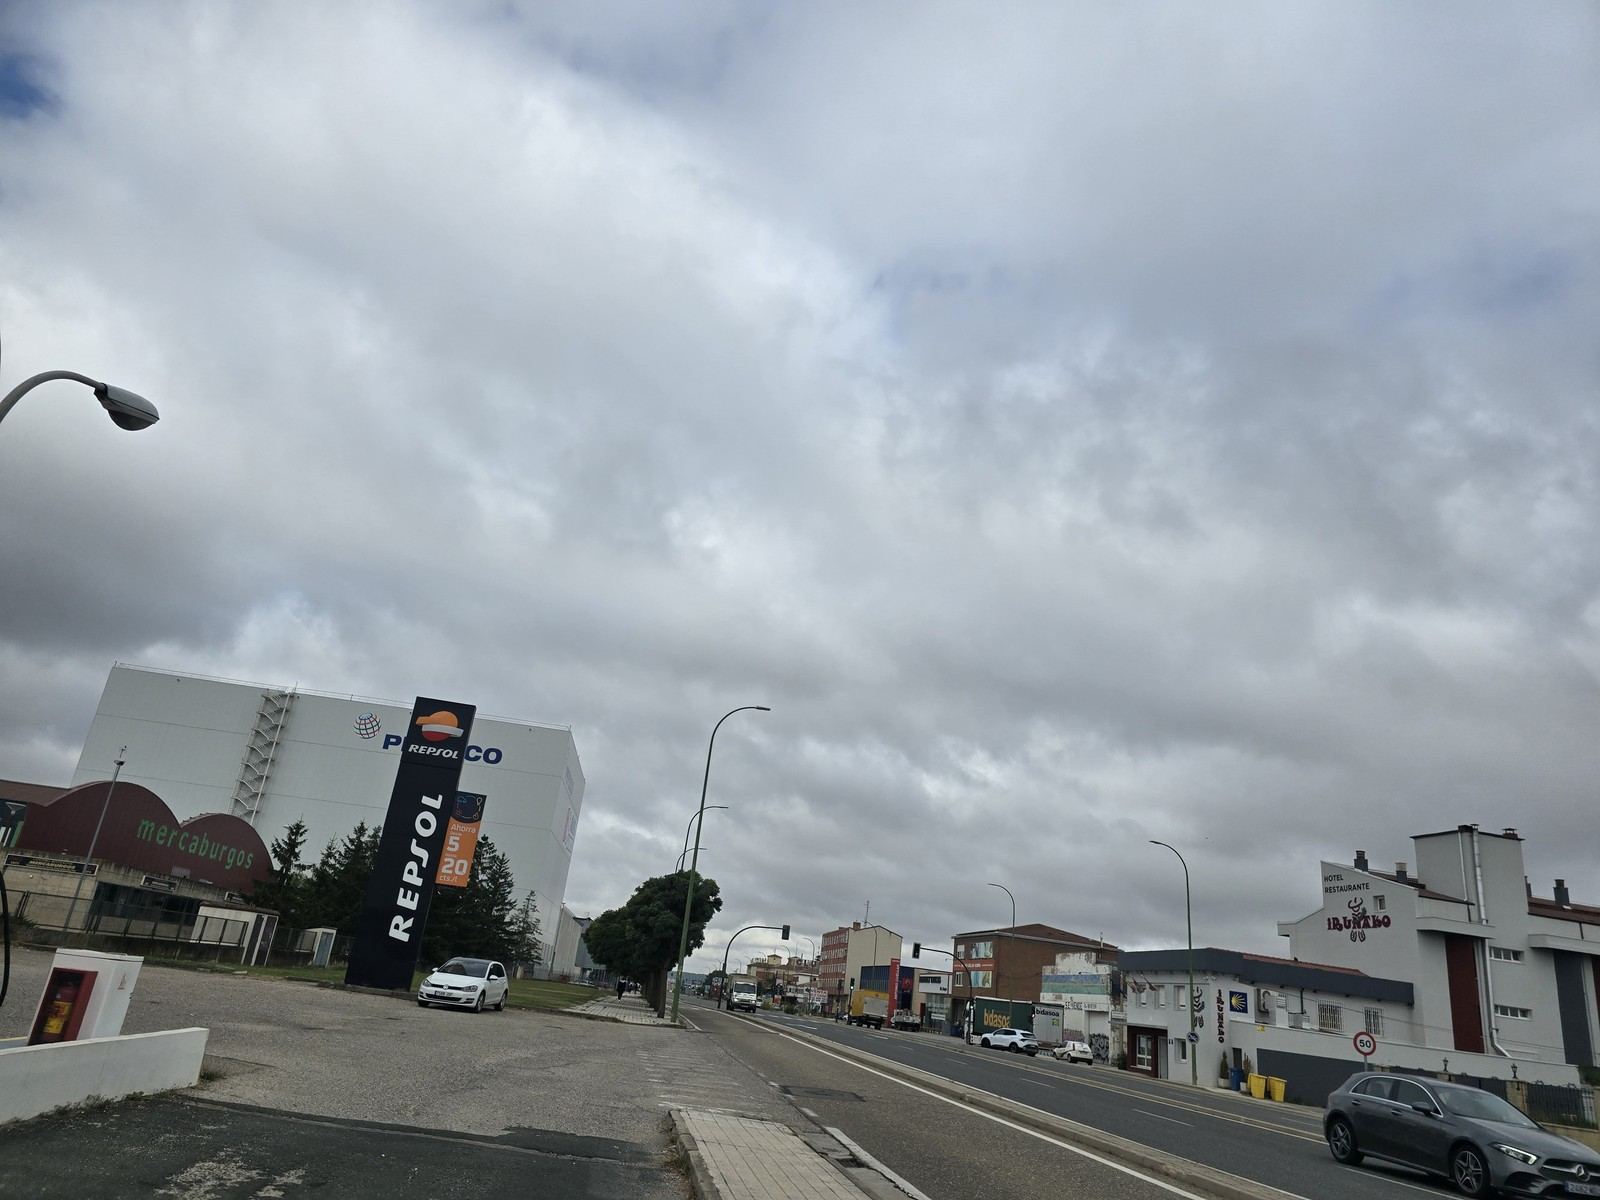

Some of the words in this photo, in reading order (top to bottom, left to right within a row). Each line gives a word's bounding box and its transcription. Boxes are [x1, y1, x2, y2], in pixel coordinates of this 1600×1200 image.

[408, 744, 461, 760] REPSOL
[450, 823, 476, 834] Ahorra
[137, 818, 254, 870] mercaburgos
[447, 836, 461, 852] 5
[388, 793, 443, 944] REPSOL
[441, 857, 468, 876] 20
[1323, 874, 1344, 883] HOTEL
[1324, 882, 1370, 894] RESTAURANTE
[1359, 1039, 1371, 1048] 50
